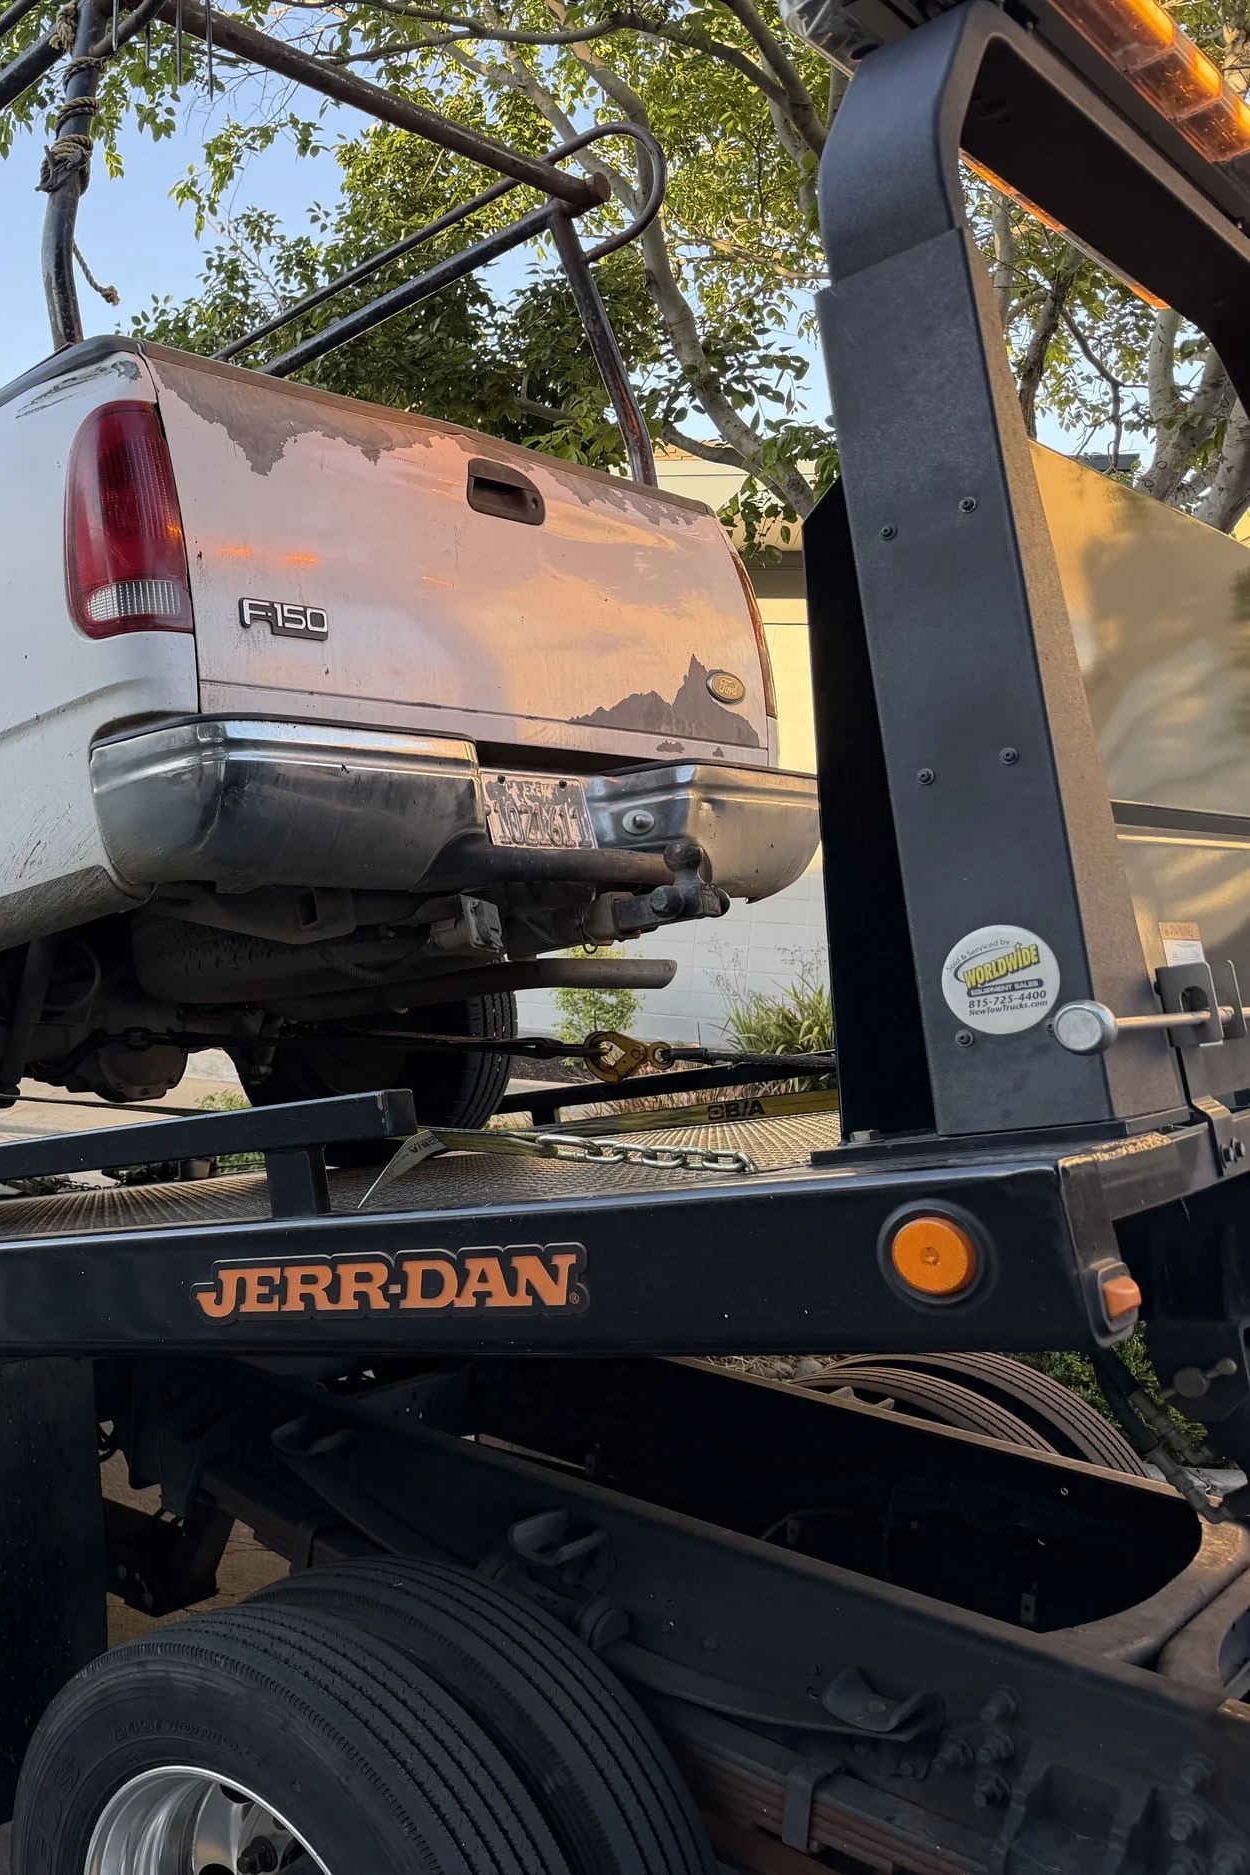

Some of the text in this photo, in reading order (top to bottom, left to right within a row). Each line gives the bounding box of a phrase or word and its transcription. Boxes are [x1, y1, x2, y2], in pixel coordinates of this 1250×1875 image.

[242, 598, 328, 633] F-150
[718, 677, 739, 696] Ford
[945, 938, 1010, 972] Sold & Serviced by
[963, 943, 1040, 989] WORLDWIDE
[970, 979, 1039, 996] EQUIPMENT SALES
[968, 990, 1047, 1009] 815-725-4400
[968, 1000, 1048, 1016] NewTowTrucks.com
[725, 1100, 766, 1118] B/A
[195, 1253, 577, 1318] JERR-DAN
